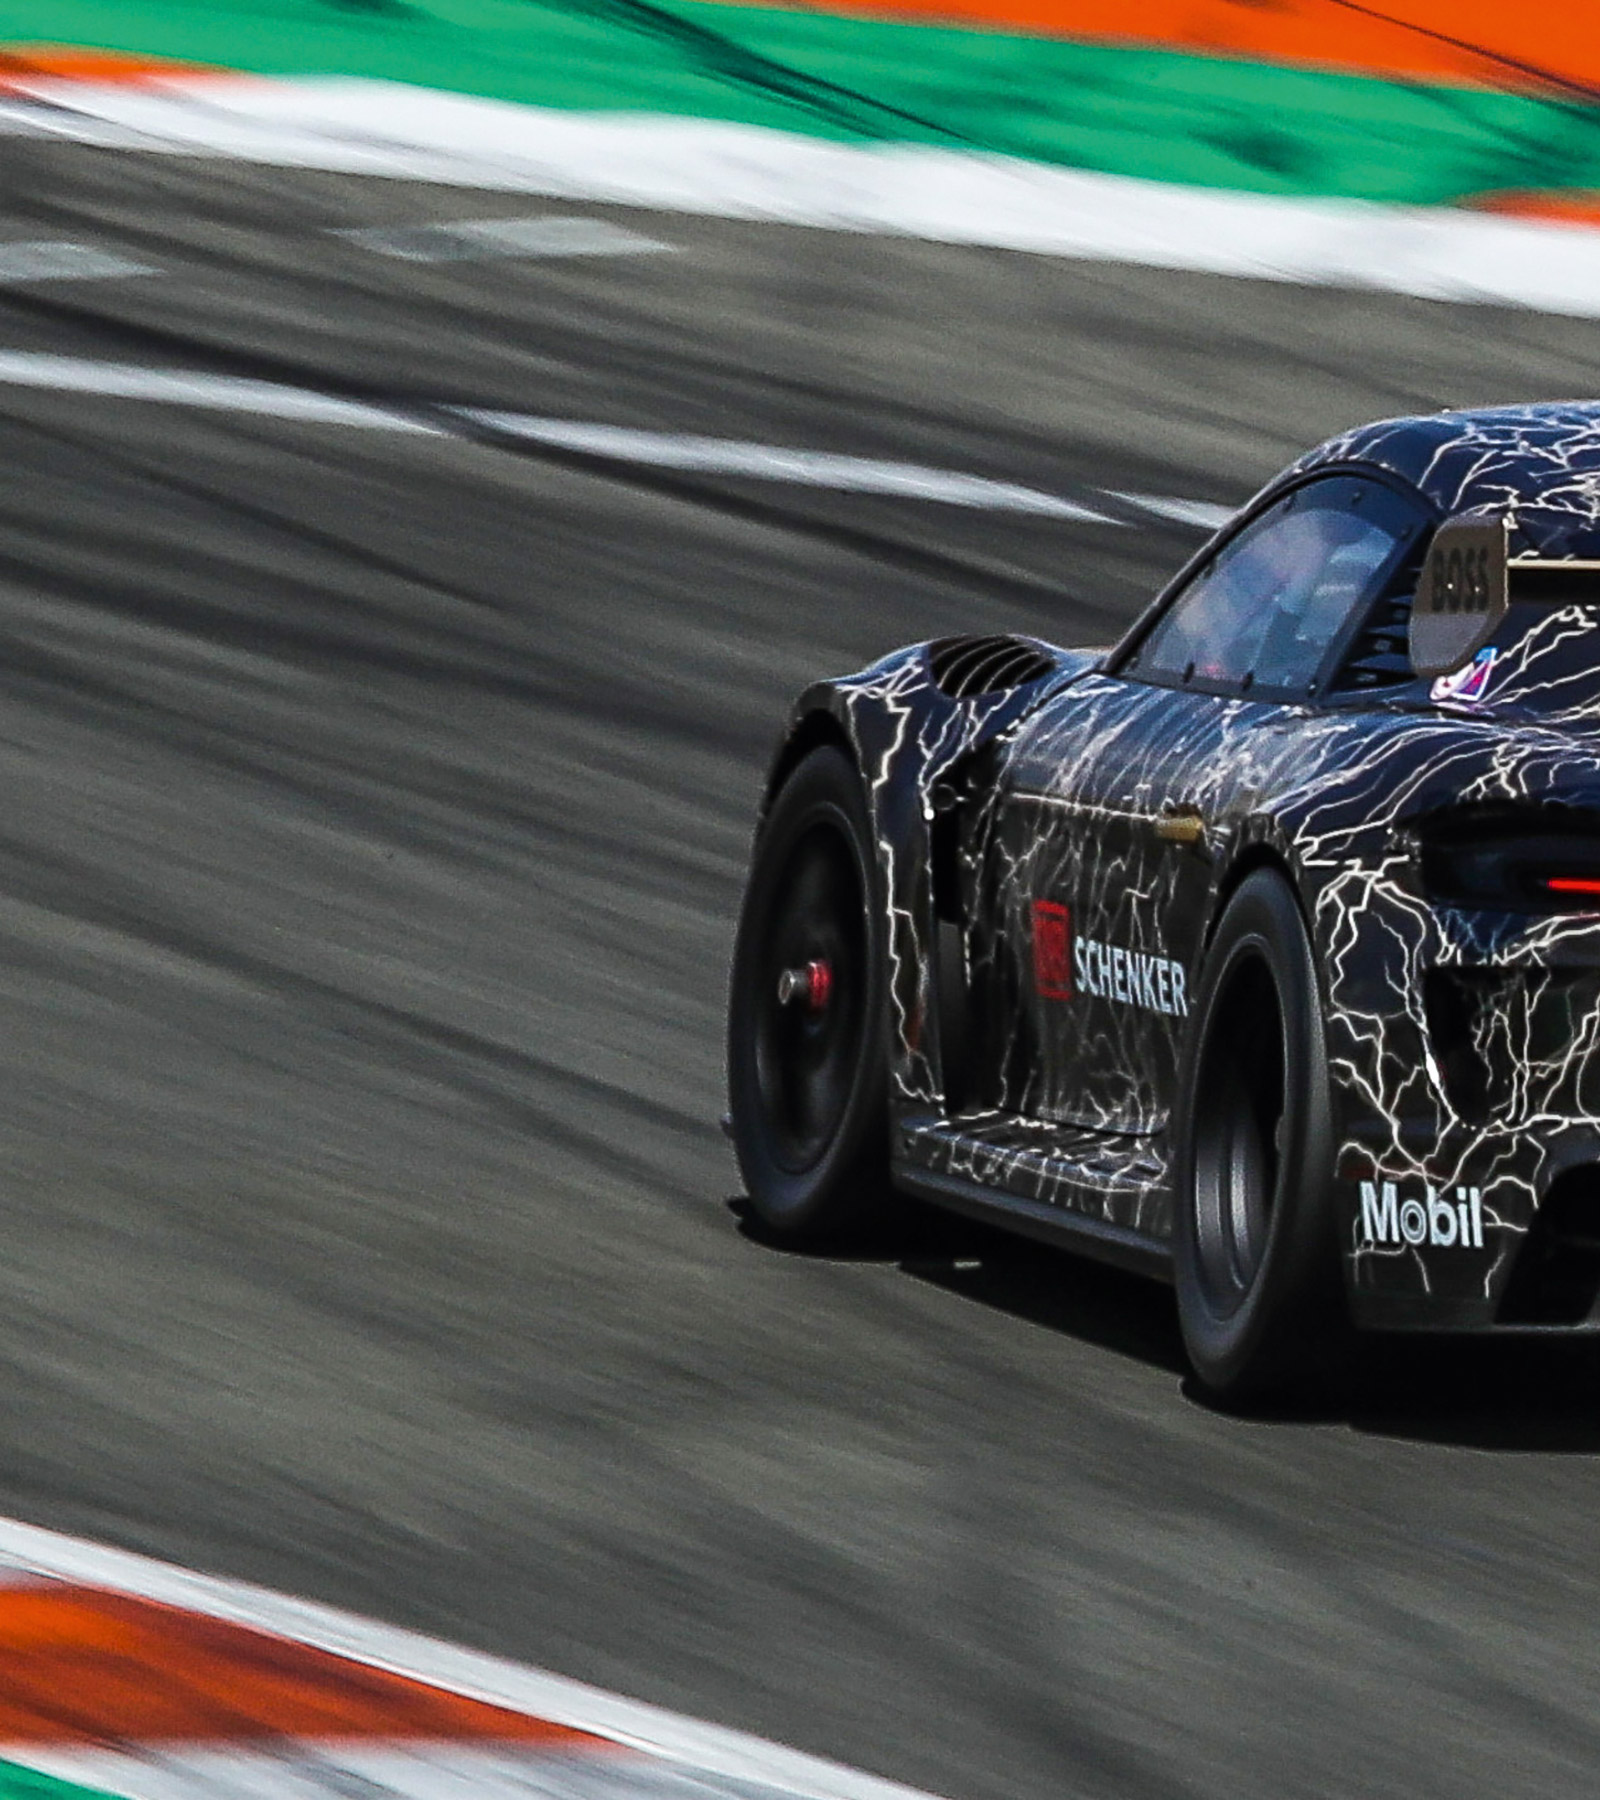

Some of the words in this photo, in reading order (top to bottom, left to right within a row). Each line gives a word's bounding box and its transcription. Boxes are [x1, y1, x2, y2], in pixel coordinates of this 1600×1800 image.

[1431, 547, 1489, 614] BOSS
[1075, 935, 1188, 1018] SCHENKER
[1359, 1180, 1484, 1248] Mobil
